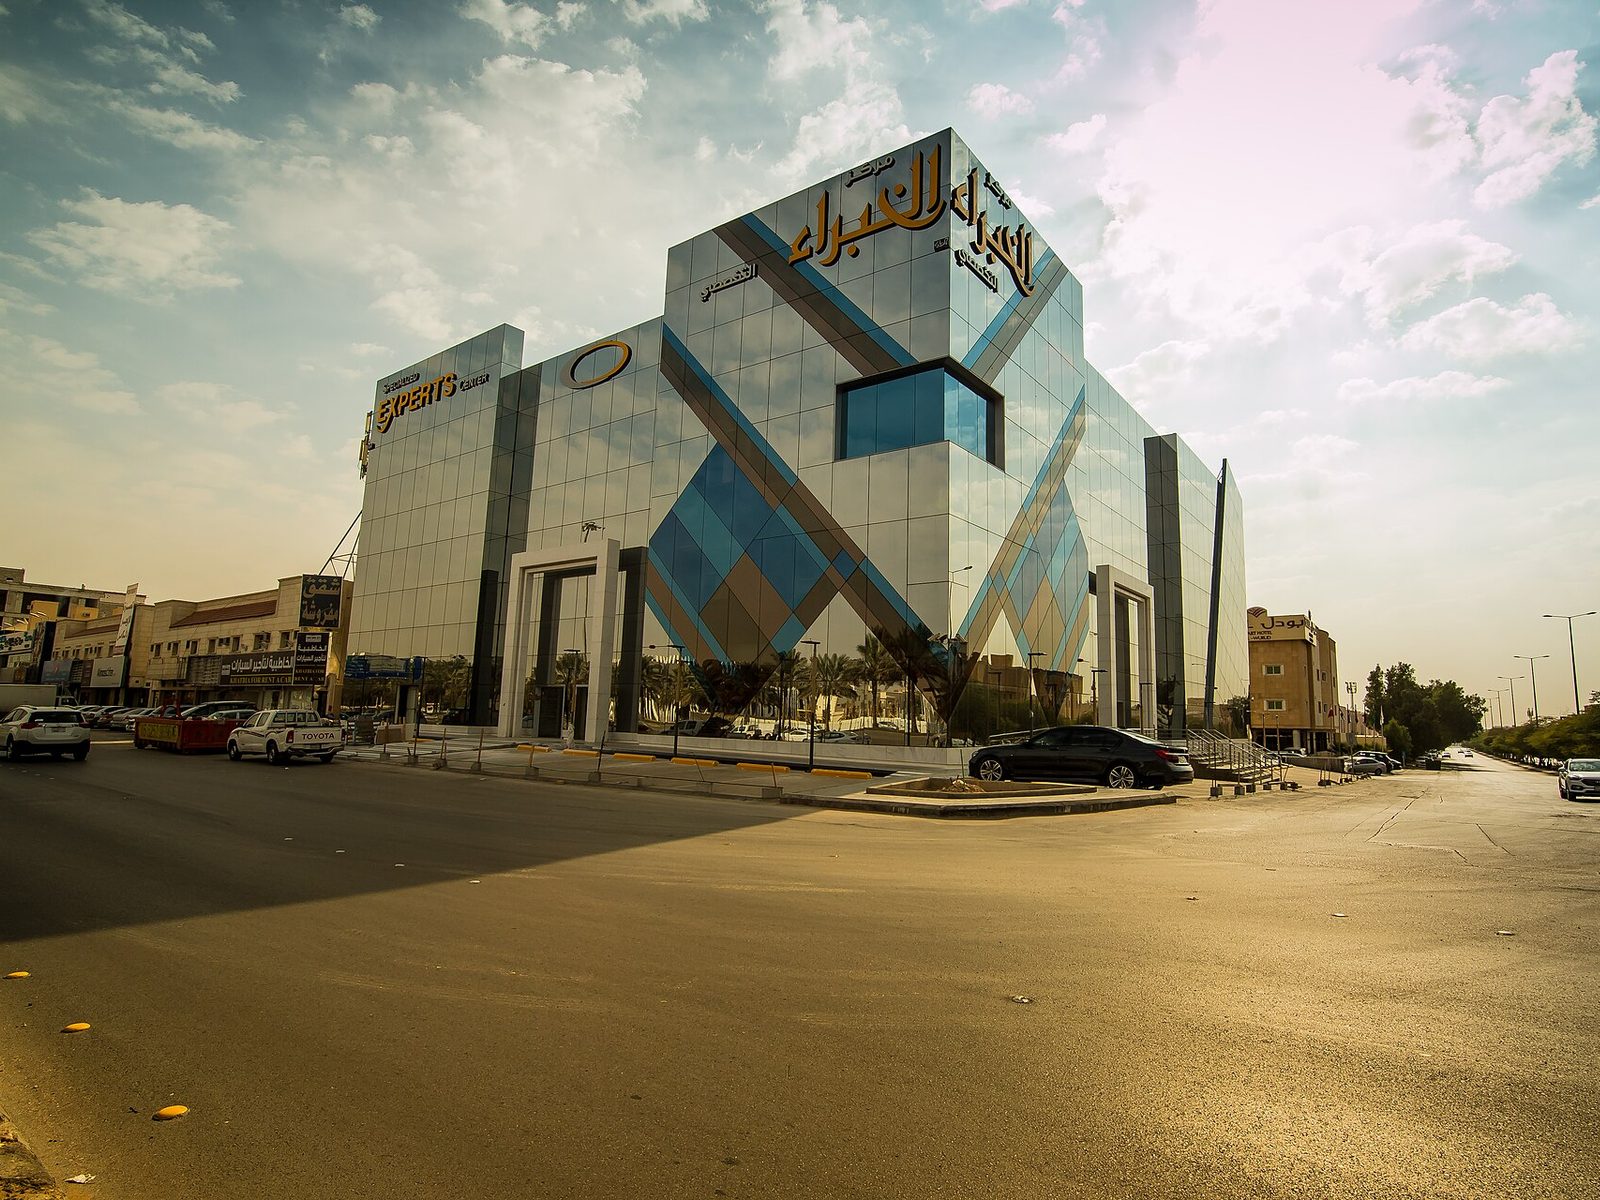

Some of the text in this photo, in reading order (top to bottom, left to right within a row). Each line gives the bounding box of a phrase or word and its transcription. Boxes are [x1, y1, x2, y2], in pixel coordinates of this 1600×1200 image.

[845, 155, 896, 188] مركز
[788, 143, 947, 266] الخبراء
[700, 263, 758, 303] التخصصي
[383, 372, 420, 394] SPECIALIZED
[376, 372, 490, 434] EXPERTS CENTER
[1261, 616, 1304, 629] بودل
[301, 732, 335, 740] TOYOTA
